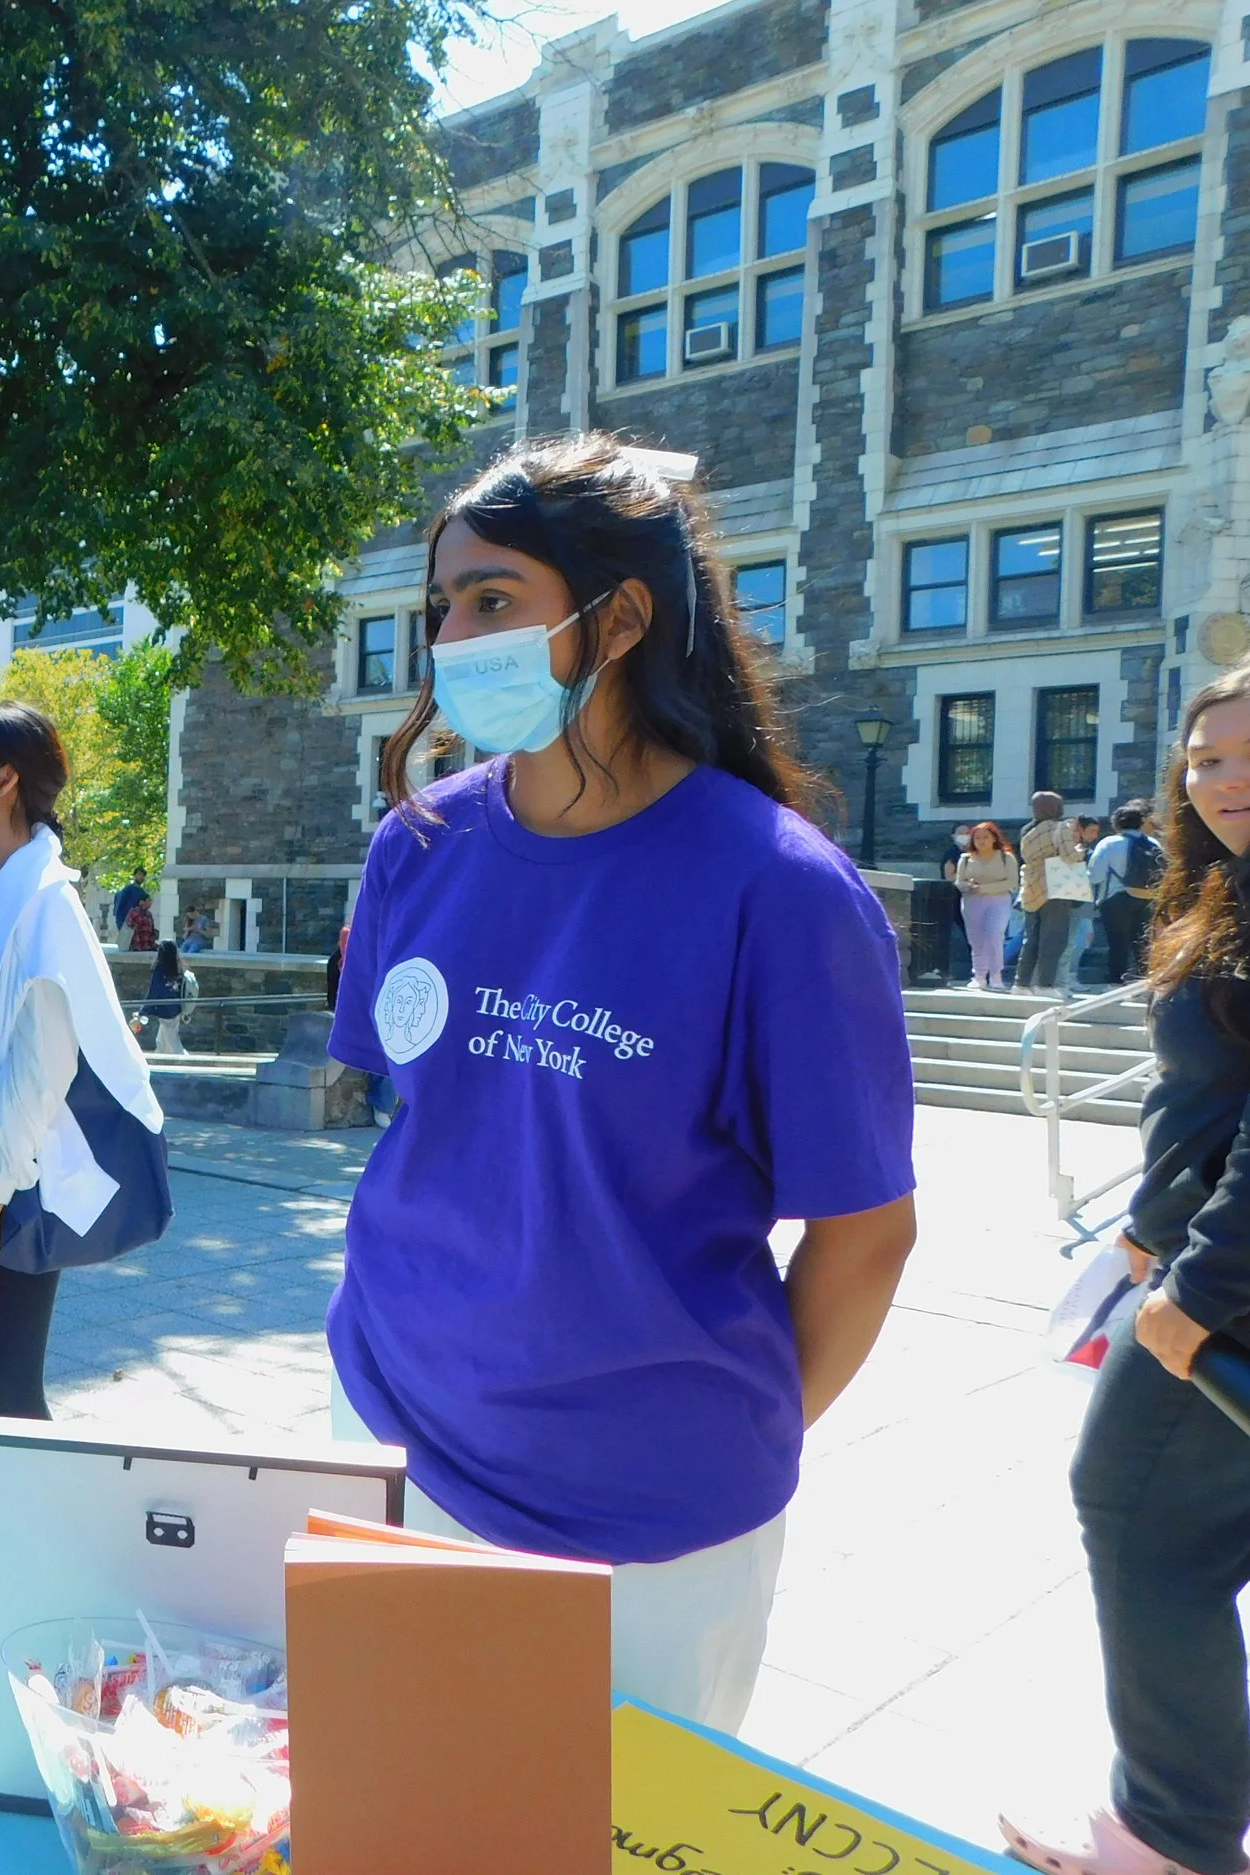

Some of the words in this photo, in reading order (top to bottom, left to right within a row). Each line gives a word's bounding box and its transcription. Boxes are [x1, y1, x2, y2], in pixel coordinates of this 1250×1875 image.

[475, 655, 520, 674] USA
[475, 986, 521, 1019] The
[521, 993, 551, 1030] City
[552, 999, 654, 1059] College
[469, 1030, 503, 1057] of
[535, 1038, 586, 1079] York
[728, 1792, 950, 1875] CCNY
